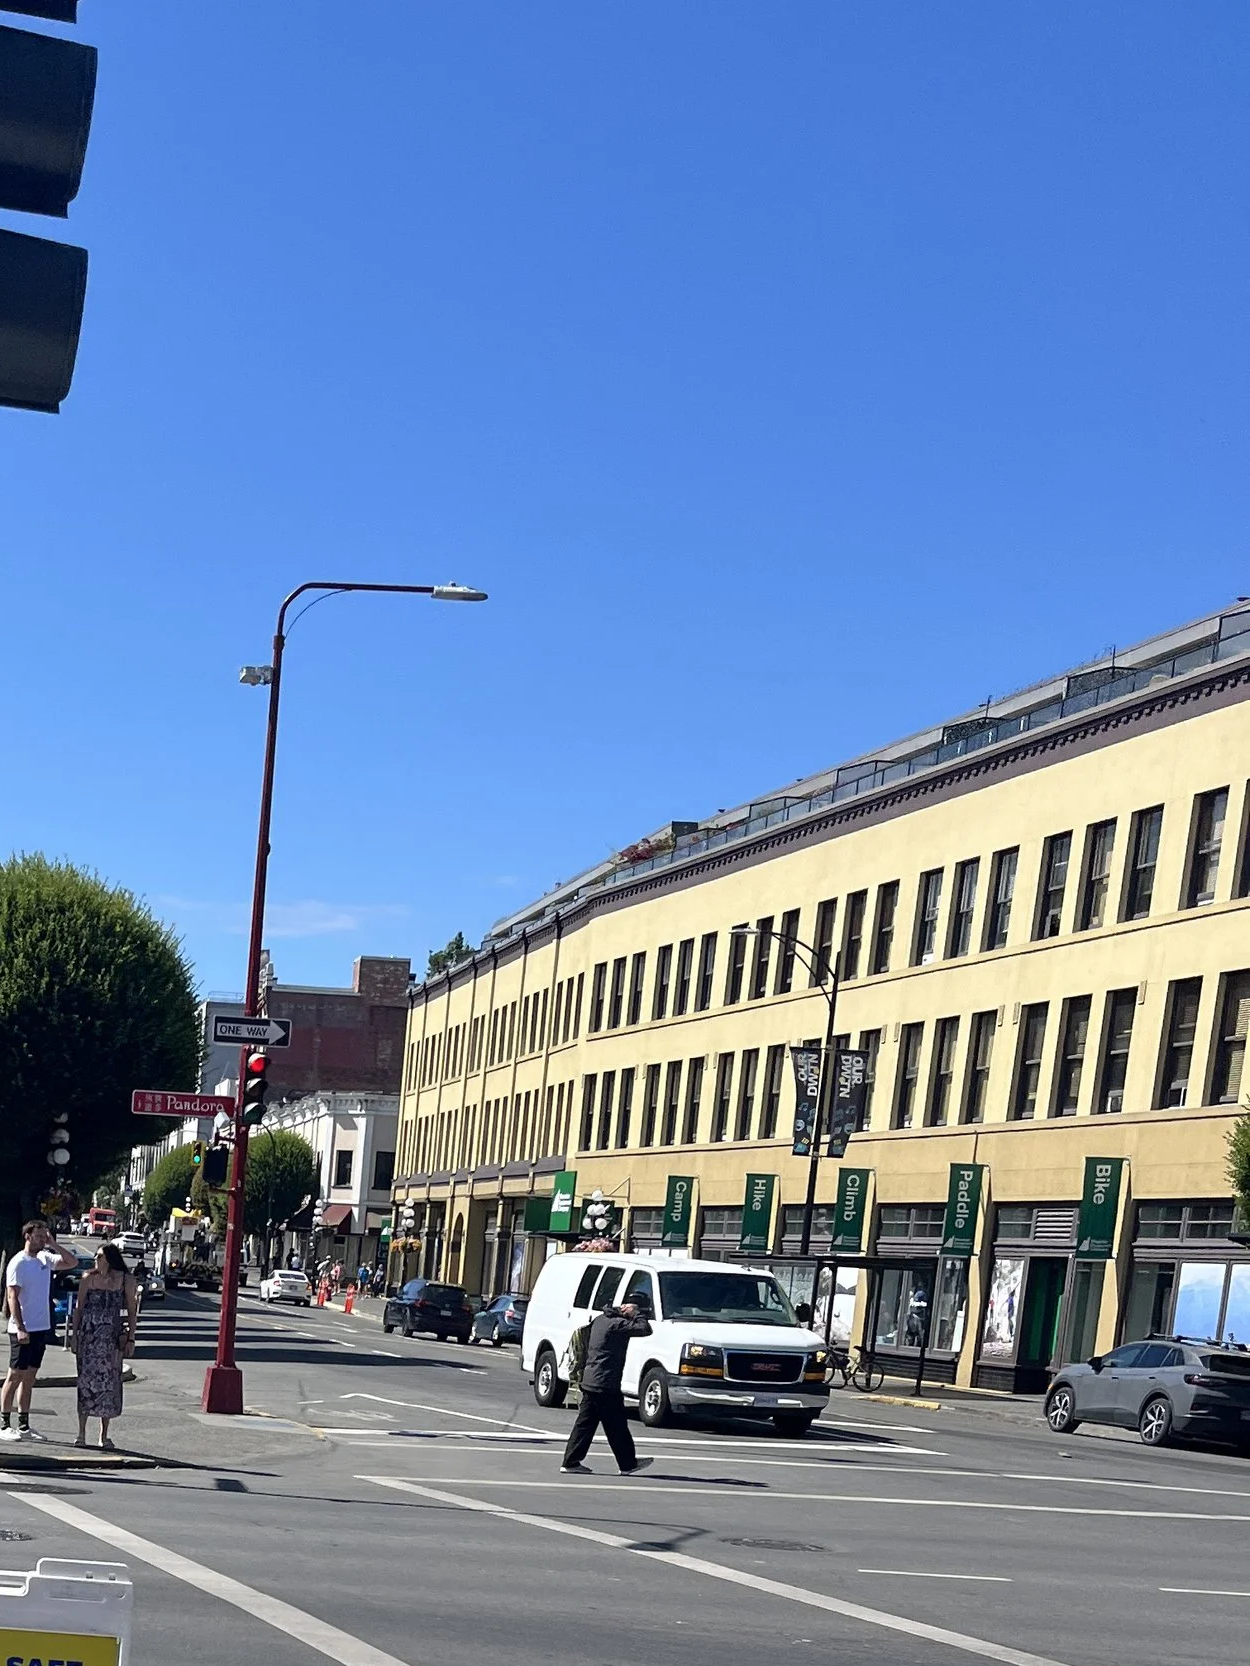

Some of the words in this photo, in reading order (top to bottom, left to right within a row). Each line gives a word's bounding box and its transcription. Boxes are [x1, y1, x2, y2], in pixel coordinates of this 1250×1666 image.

[219, 1024, 242, 1035] ONE
[246, 1026, 268, 1037] WAY
[797, 1051, 808, 1082] OUR
[852, 1056, 864, 1085] OUR
[167, 1095, 225, 1112] Pandora
[752, 1179, 767, 1211] Hike
[843, 1174, 860, 1222] Climb
[954, 1170, 974, 1229] Paddle
[1092, 1164, 1112, 1205] Bike
[670, 1181, 687, 1222] Camp
